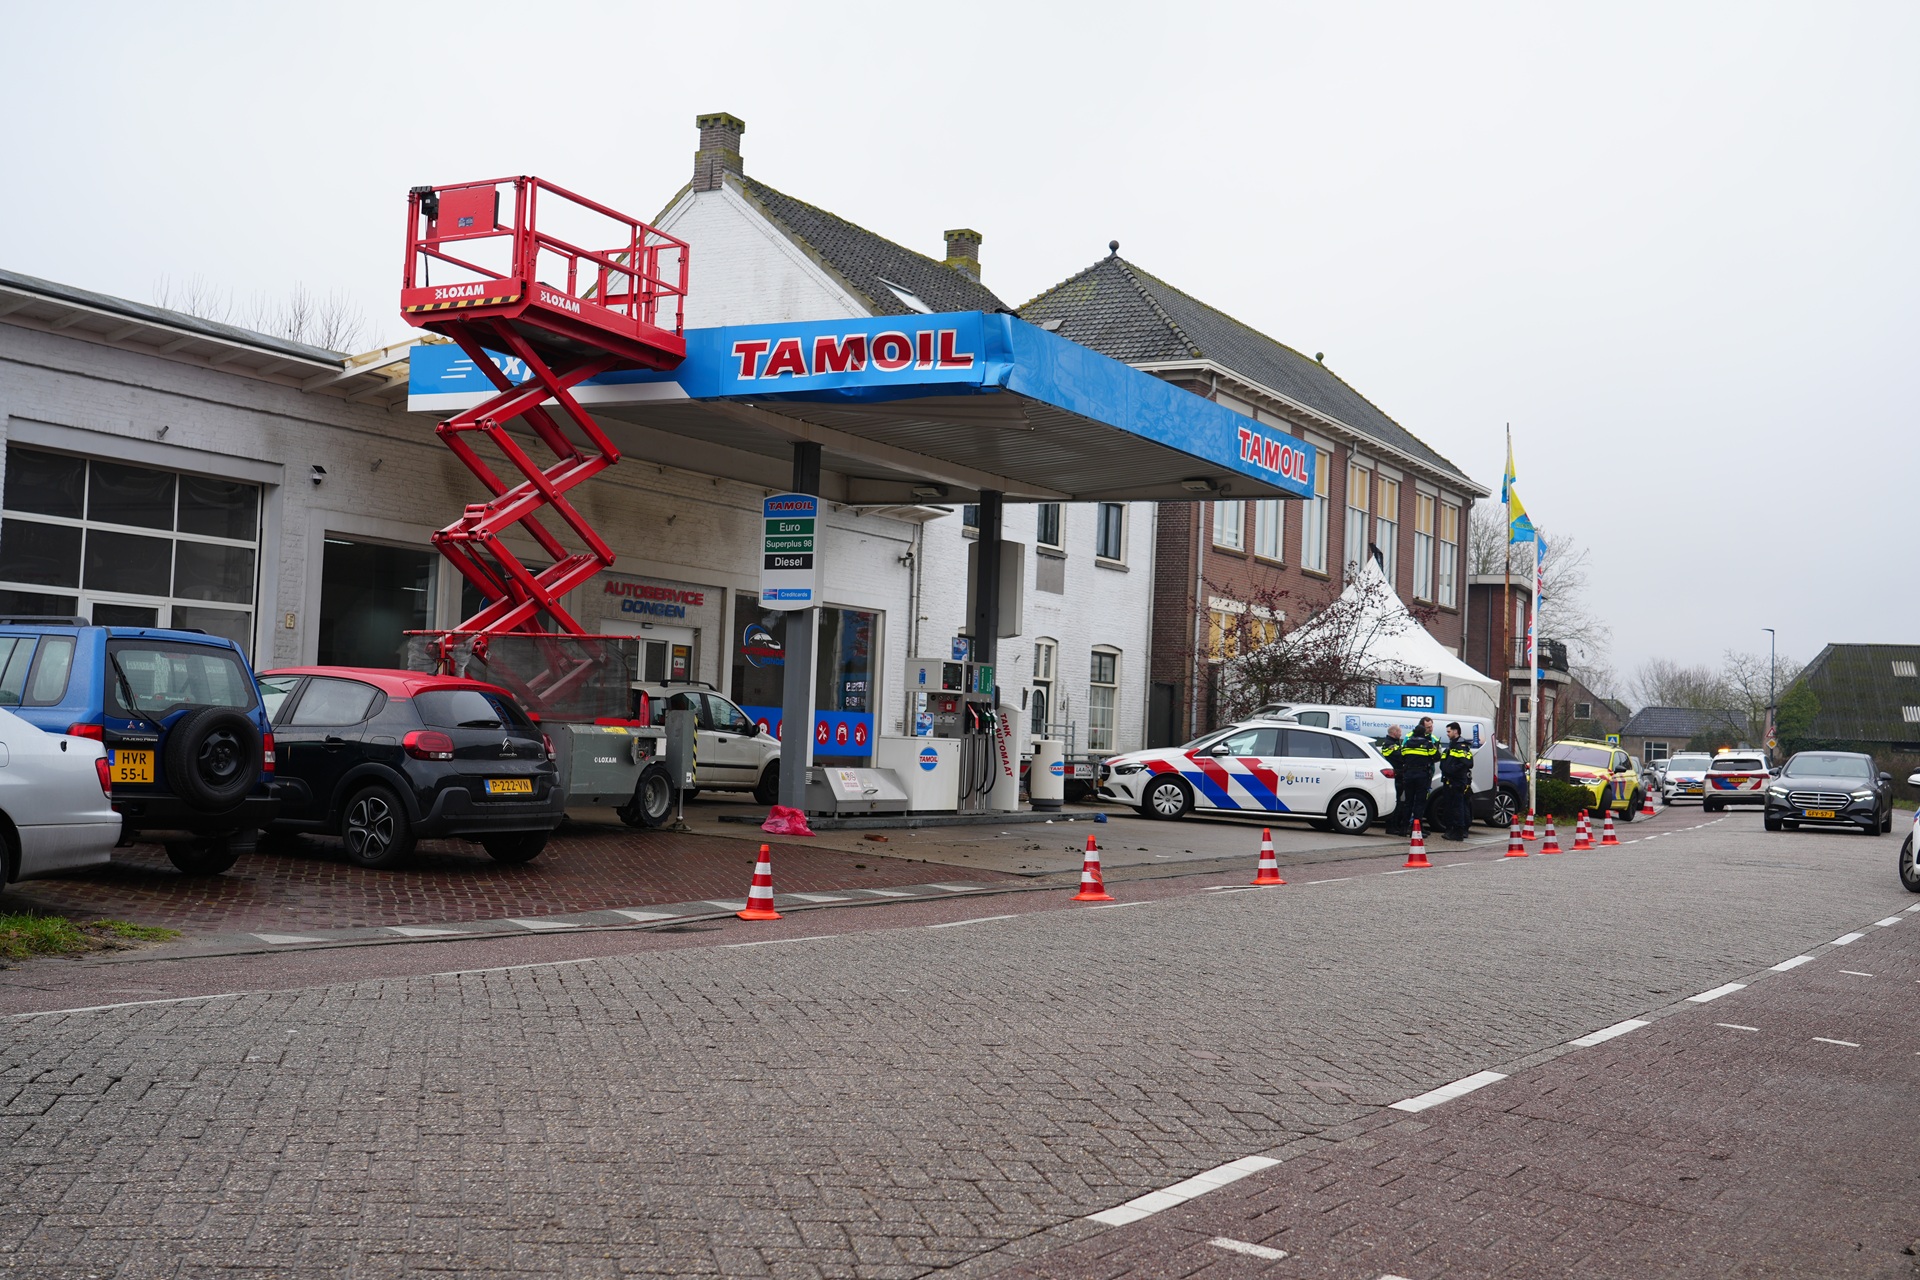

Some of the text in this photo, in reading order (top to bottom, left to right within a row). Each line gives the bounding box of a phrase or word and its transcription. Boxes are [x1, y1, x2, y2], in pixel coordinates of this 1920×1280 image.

[442, 284, 485, 298] LOXAM
[547, 292, 581, 314] LOXAM
[731, 329, 975, 380] TAMOIL
[1237, 425, 1309, 485] TAMOIL
[768, 501, 814, 511] TAMOIL
[779, 522, 801, 532] Euro
[766, 539, 813, 549] Superplus 98
[774, 556, 803, 567] Diesel
[604, 580, 704, 606] AUTOSERVICE
[621, 598, 686, 619] DONGEN
[1406, 695, 1433, 708] 199.9
[1000, 713, 1012, 737] TANK
[122, 752, 147, 764] HVR
[995, 728, 1014, 777] AUTOMAAT
[919, 755, 938, 764] TAMOIL
[120, 768, 148, 780] 55-L
[1280, 774, 1320, 785] POLITIE
[491, 780, 530, 791] P-222-VN
